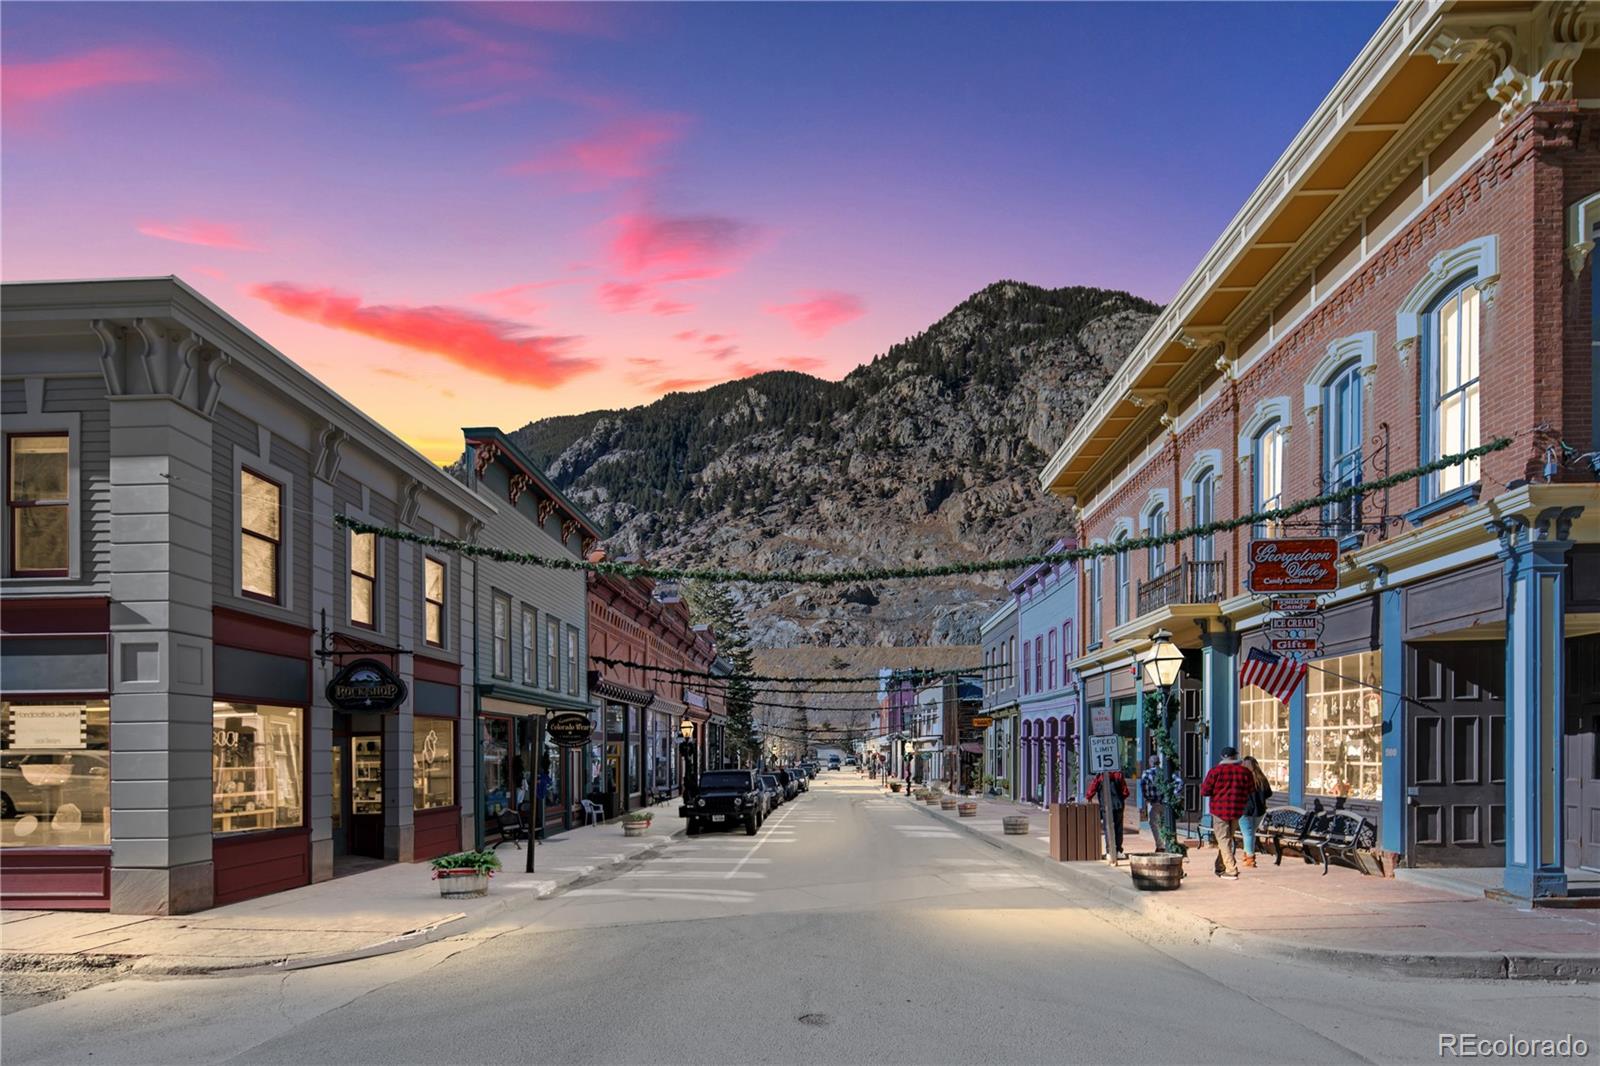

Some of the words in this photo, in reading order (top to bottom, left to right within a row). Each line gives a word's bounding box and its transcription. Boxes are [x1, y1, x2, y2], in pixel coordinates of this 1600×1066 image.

[1255, 544, 1332, 568] Georgetown
[1287, 562, 1328, 580] Valley
[1285, 577, 1313, 585] Company
[1273, 619, 1286, 628] ICE
[1287, 619, 1314, 628] CREAM
[1276, 640, 1307, 649] Gifts
[367, 684, 398, 698] SHOP
[16, 710, 55, 718] Handcrafted
[1096, 754, 1114, 768] 15
